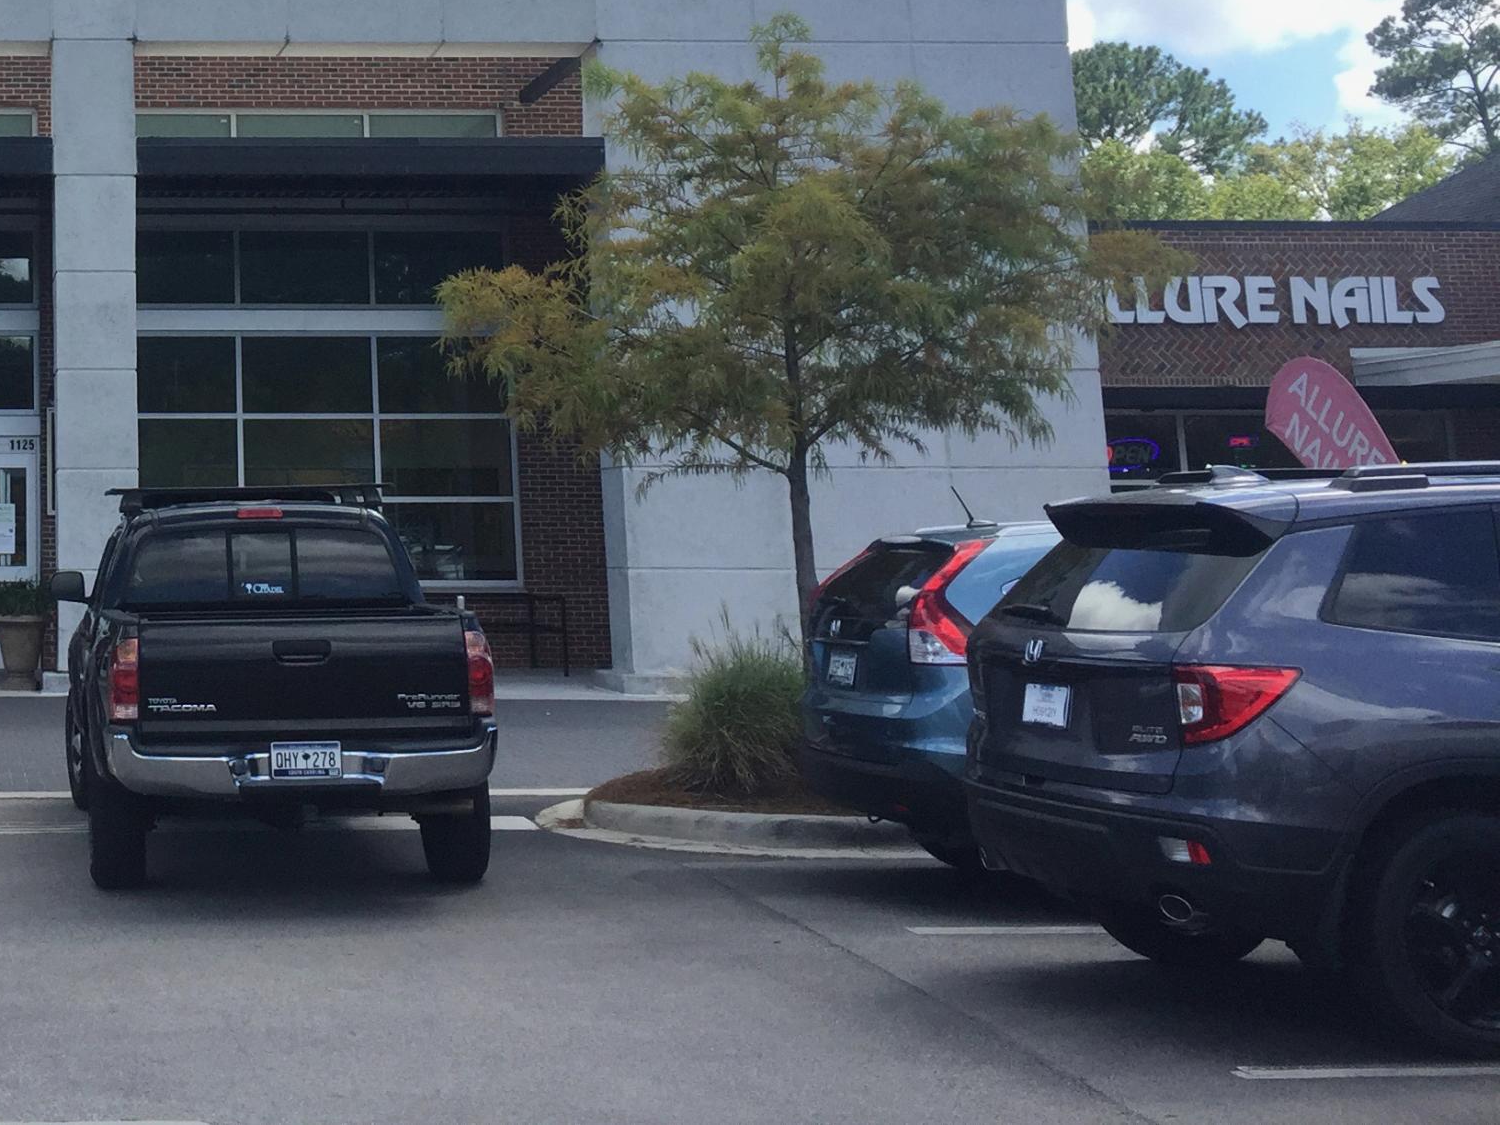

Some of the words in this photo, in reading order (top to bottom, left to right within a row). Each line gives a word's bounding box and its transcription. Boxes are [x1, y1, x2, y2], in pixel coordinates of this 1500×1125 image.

[1104, 274, 1280, 329] LLURE
[1289, 275, 1446, 329] NAILS
[10, 439, 35, 451] 1125
[147, 704, 218, 713] TACOMA
[1128, 733, 1168, 744] AWD
[275, 751, 299, 769] QHY
[312, 751, 337, 768] 278
